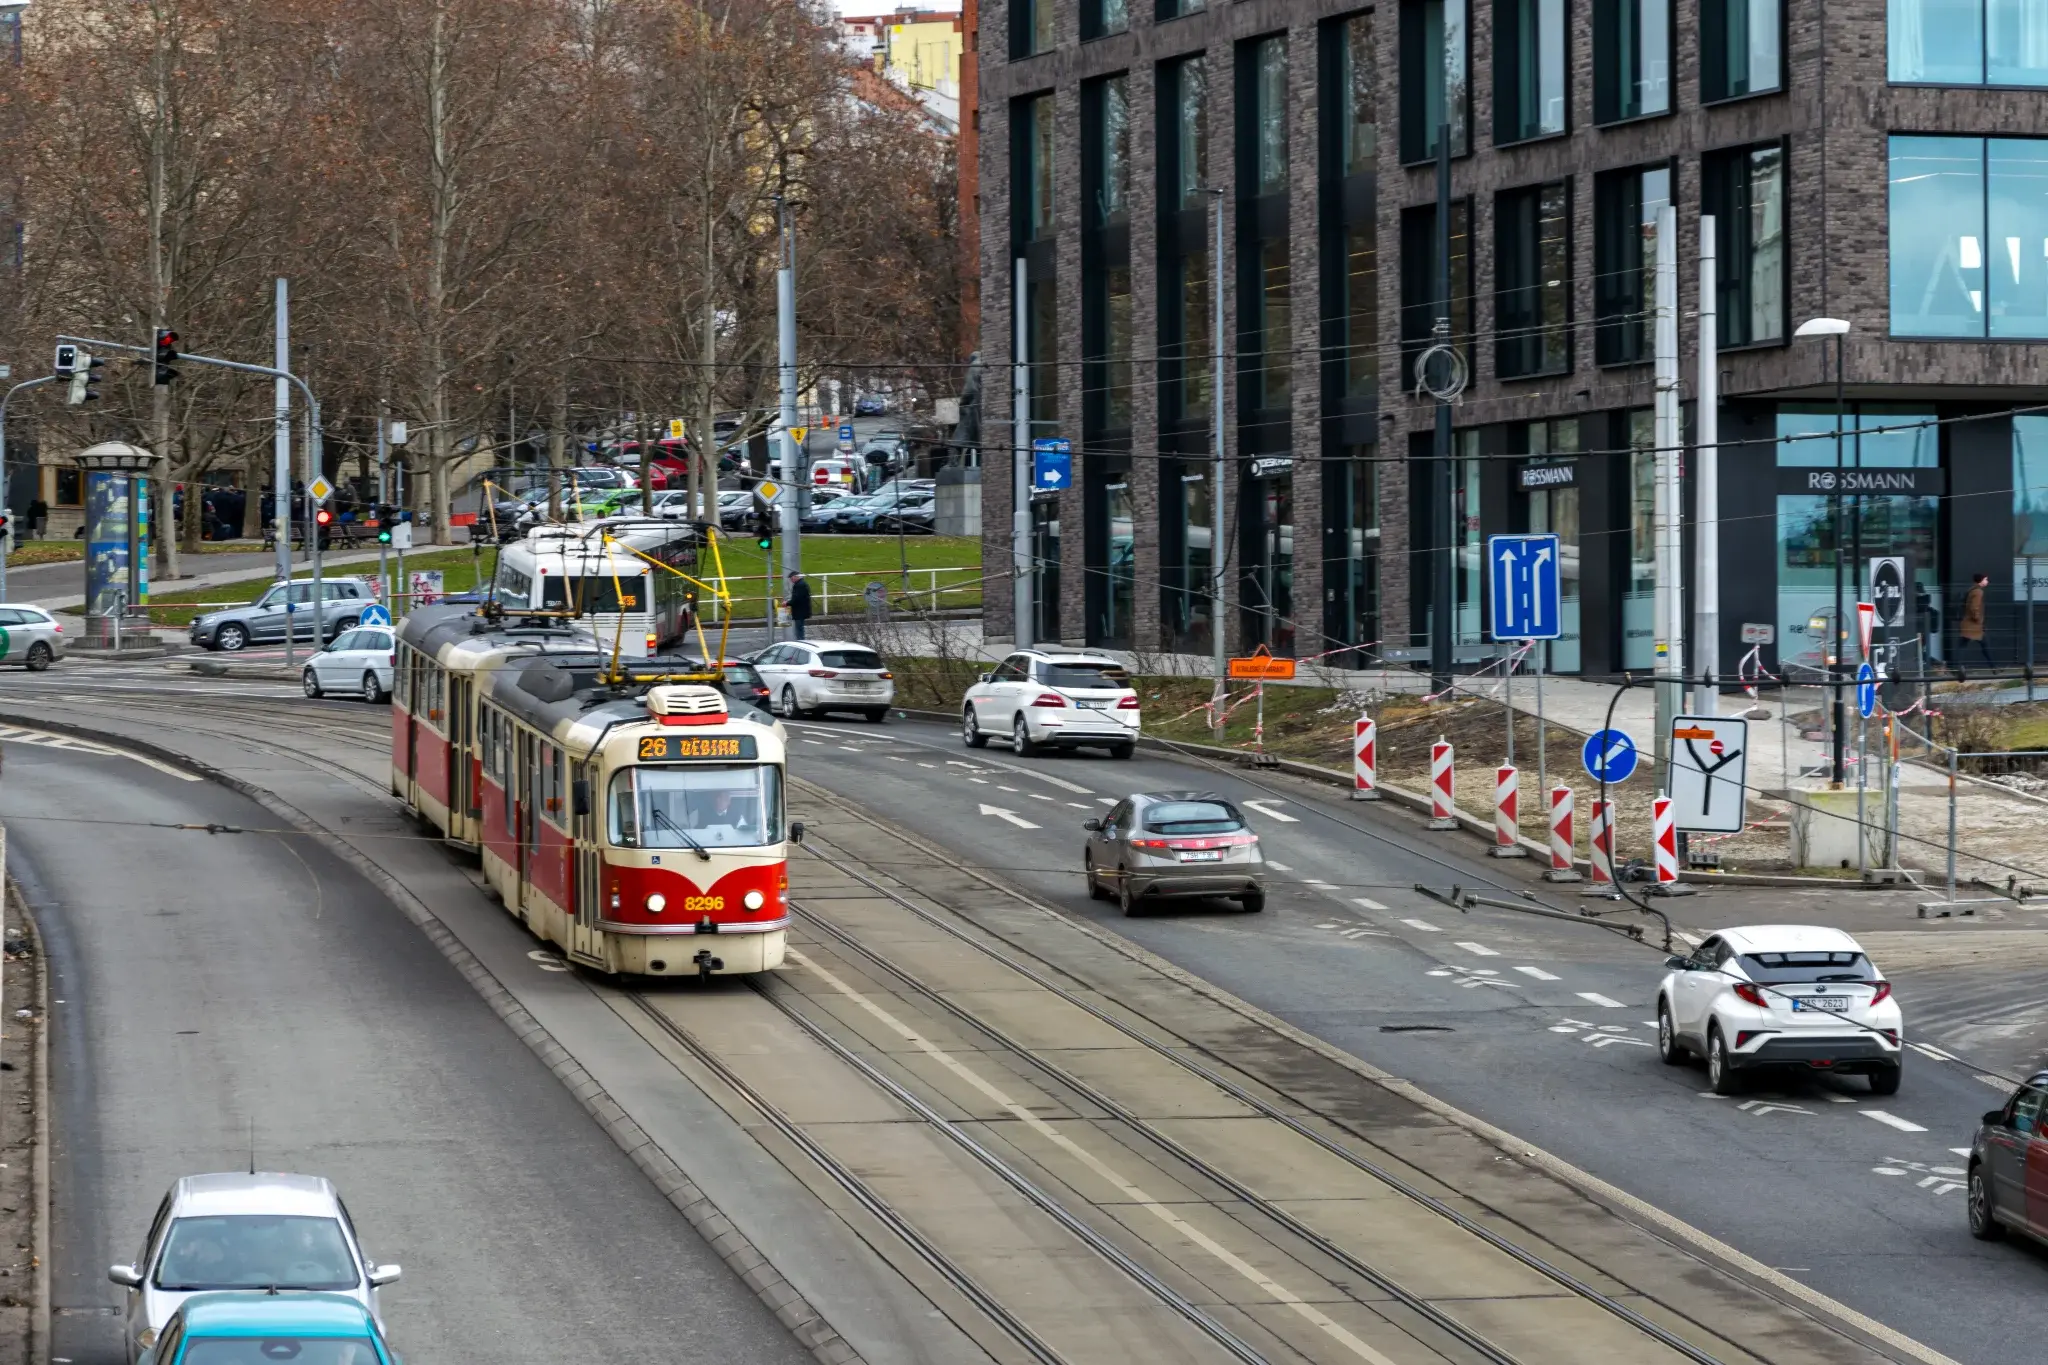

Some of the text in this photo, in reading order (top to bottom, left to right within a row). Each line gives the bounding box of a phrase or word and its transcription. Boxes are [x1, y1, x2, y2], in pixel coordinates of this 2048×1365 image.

[1522, 466, 1573, 486] ROSSMANN
[1808, 472, 1915, 489] ROSSMANN
[640, 737, 667, 757] 26
[684, 896, 725, 911] 8296
[1822, 999, 1844, 1008] 2623
